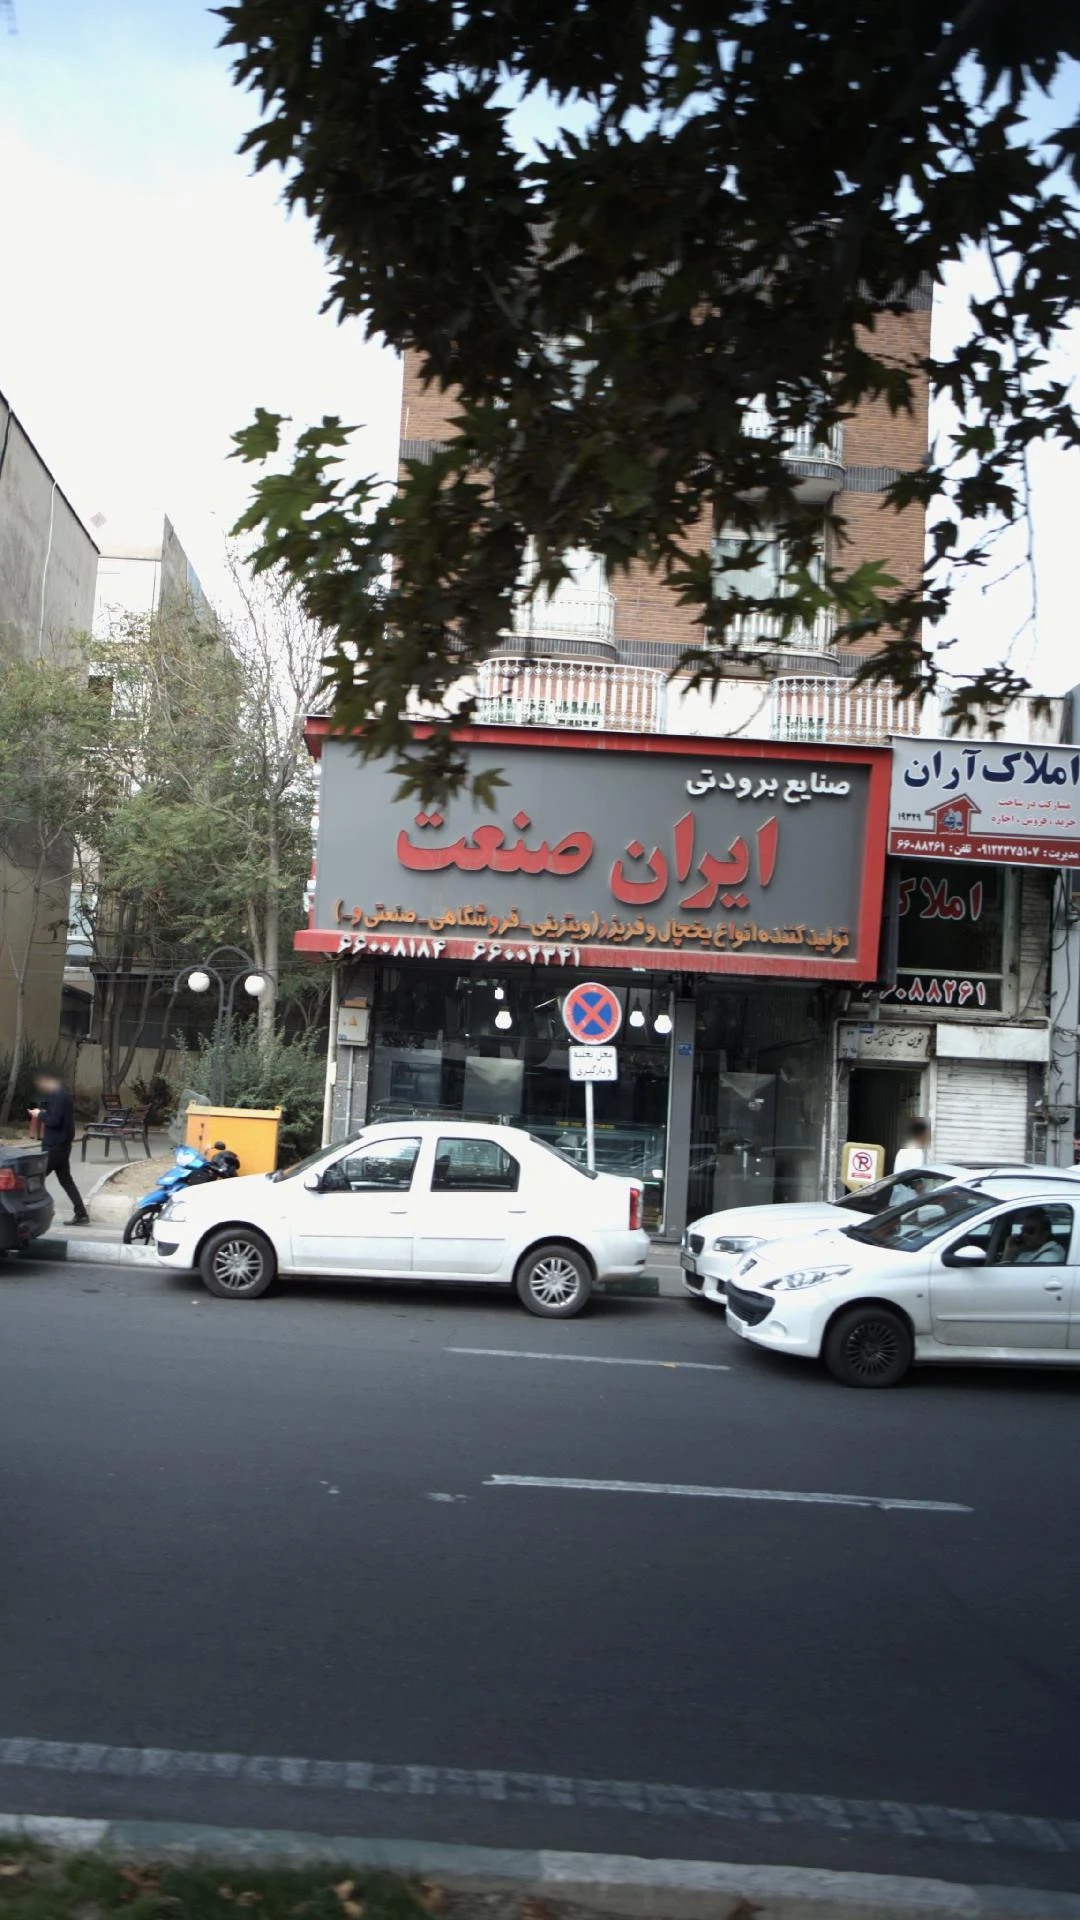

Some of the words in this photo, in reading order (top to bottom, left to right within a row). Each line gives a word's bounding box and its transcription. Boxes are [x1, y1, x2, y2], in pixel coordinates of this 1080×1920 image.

[904, 749, 982, 790] آران
[982, 750, 1080, 786] املاک
[687, 770, 779, 798] برودتی
[784, 771, 851, 803] صنایع
[397, 811, 594, 876] صنعت
[609, 811, 779, 910] ایران
[599, 914, 645, 943] فریزر
[645, 926, 656, 943] و
[657, 918, 713, 947] یخچال
[713, 921, 757, 949] انواع
[757, 923, 808, 946] کننده
[807, 926, 849, 953] تولید
[337, 934, 446, 960] ۶۶۰۰۸۱۸۴
[863, 977, 986, 1005] ۰۸۸۲۶۱
